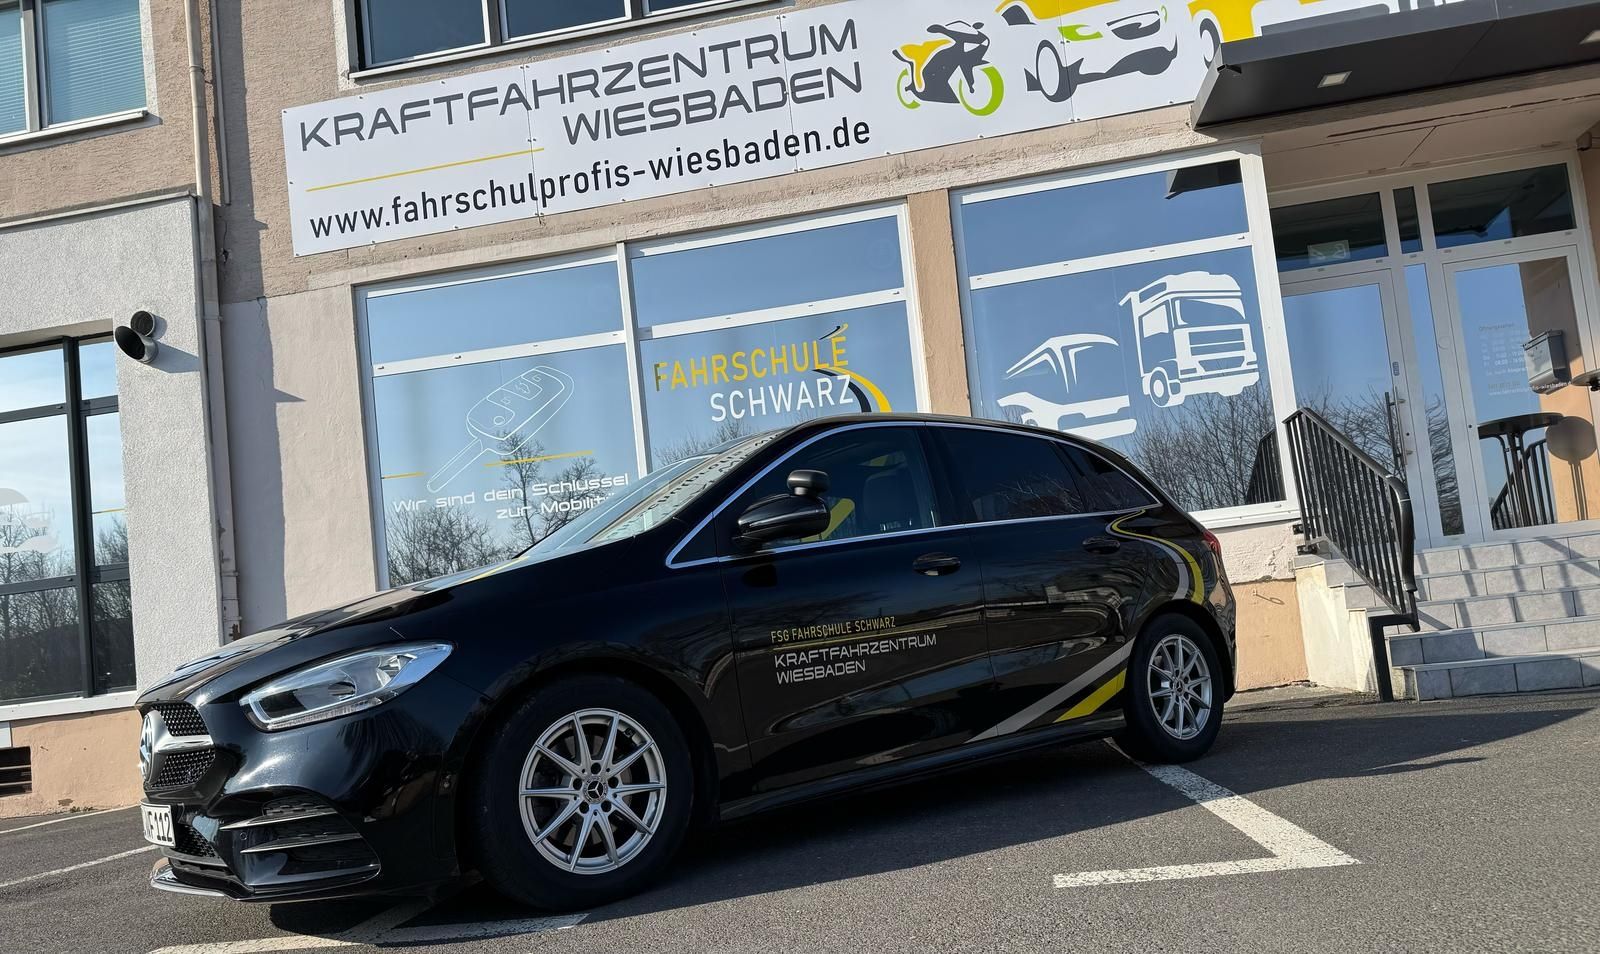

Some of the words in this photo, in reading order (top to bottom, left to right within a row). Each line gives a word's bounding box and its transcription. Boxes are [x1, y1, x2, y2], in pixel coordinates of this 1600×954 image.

[300, 18, 858, 151] KRAFTFAHRZENTRUM
[562, 61, 862, 146] WIESBADEN
[309, 116, 871, 239] www.fahrschulprofis-wiesbaden.de
[653, 335, 849, 392] FAHRSCHULE
[710, 374, 853, 422] SCHWARZ
[392, 499, 427, 512] Wir
[435, 491, 475, 508] sind
[483, 488, 524, 502] dein
[496, 506, 532, 519] zur
[771, 630, 790, 643] FSG
[791, 621, 852, 641] FAHRSCHULE
[854, 616, 896, 632] SCHWARZ
[774, 633, 937, 668] KRAFTFAHRZENTRUM
[776, 660, 866, 685] WIESBADEN
